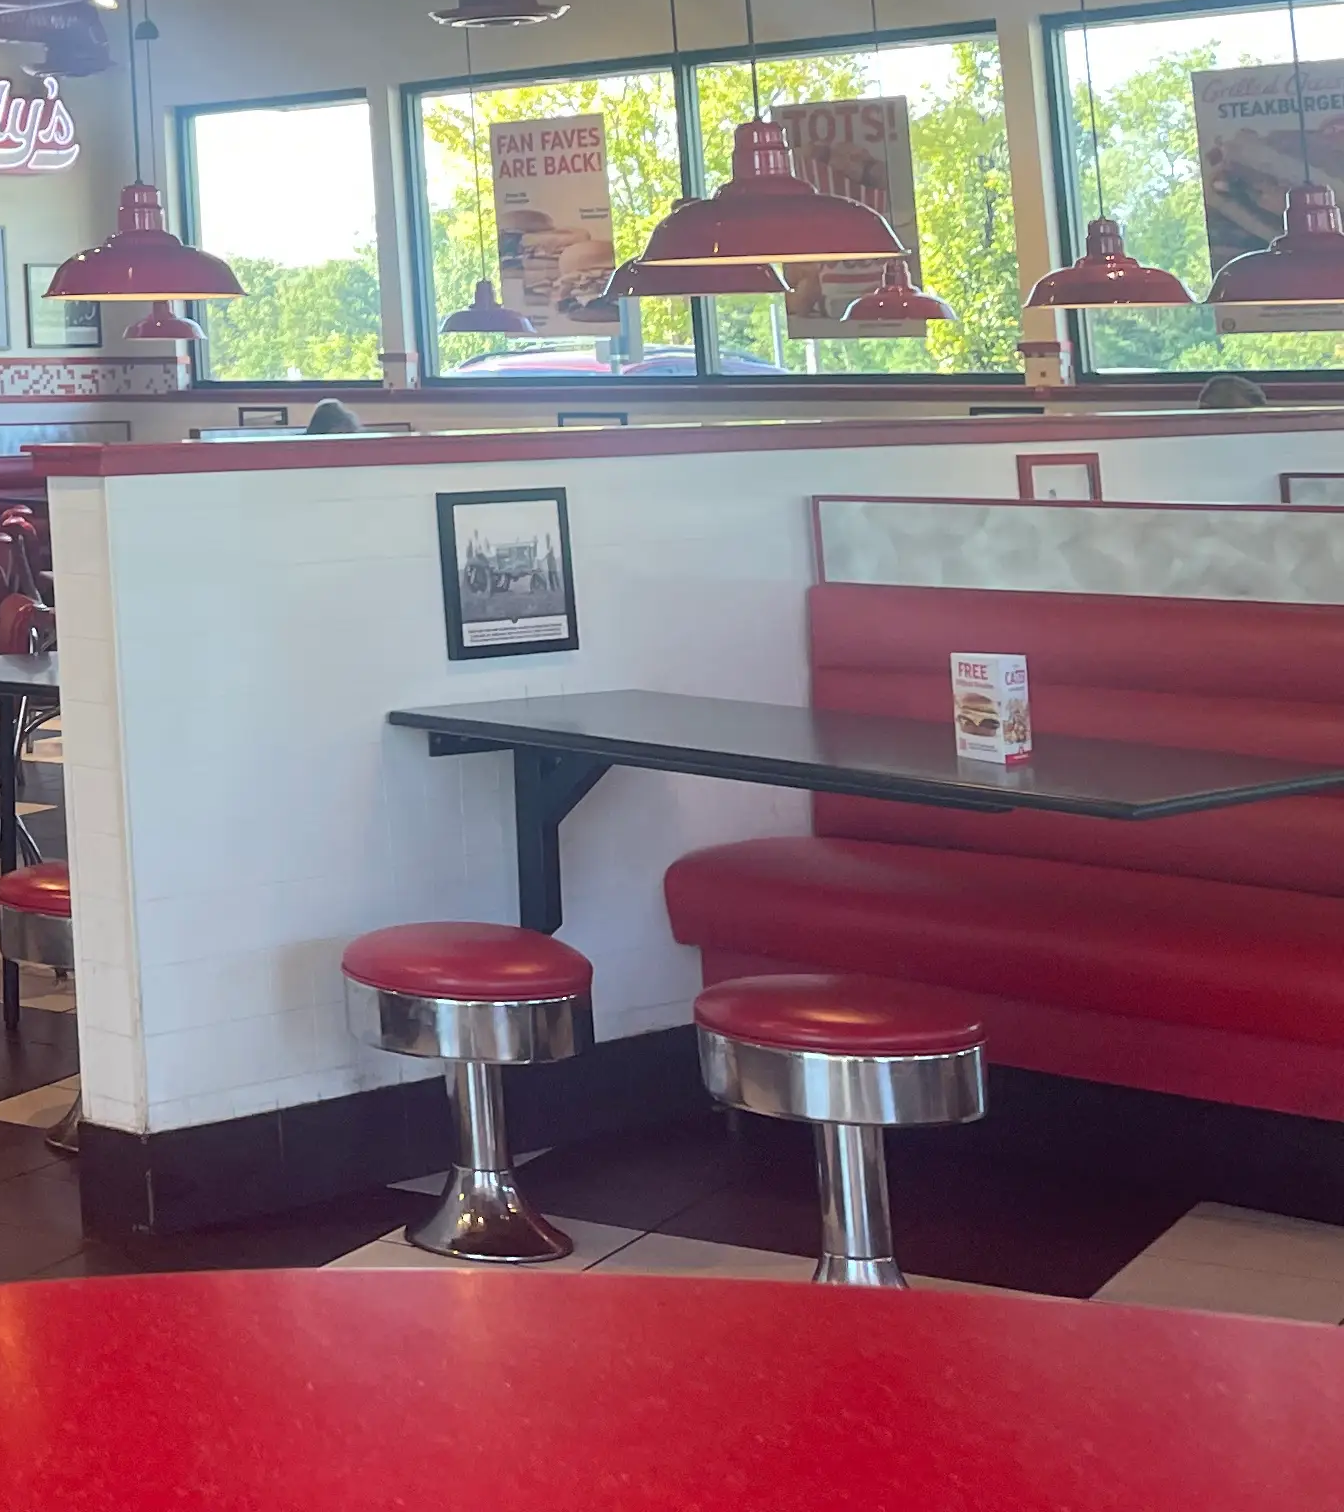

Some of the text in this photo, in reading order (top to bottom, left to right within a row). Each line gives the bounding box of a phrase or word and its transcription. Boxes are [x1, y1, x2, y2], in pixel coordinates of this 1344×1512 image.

[782, 102, 898, 148] TOTS!
[497, 128, 600, 154] FAN FAVES
[499, 152, 603, 179] ARE BACK!
[958, 662, 988, 680] FREE
